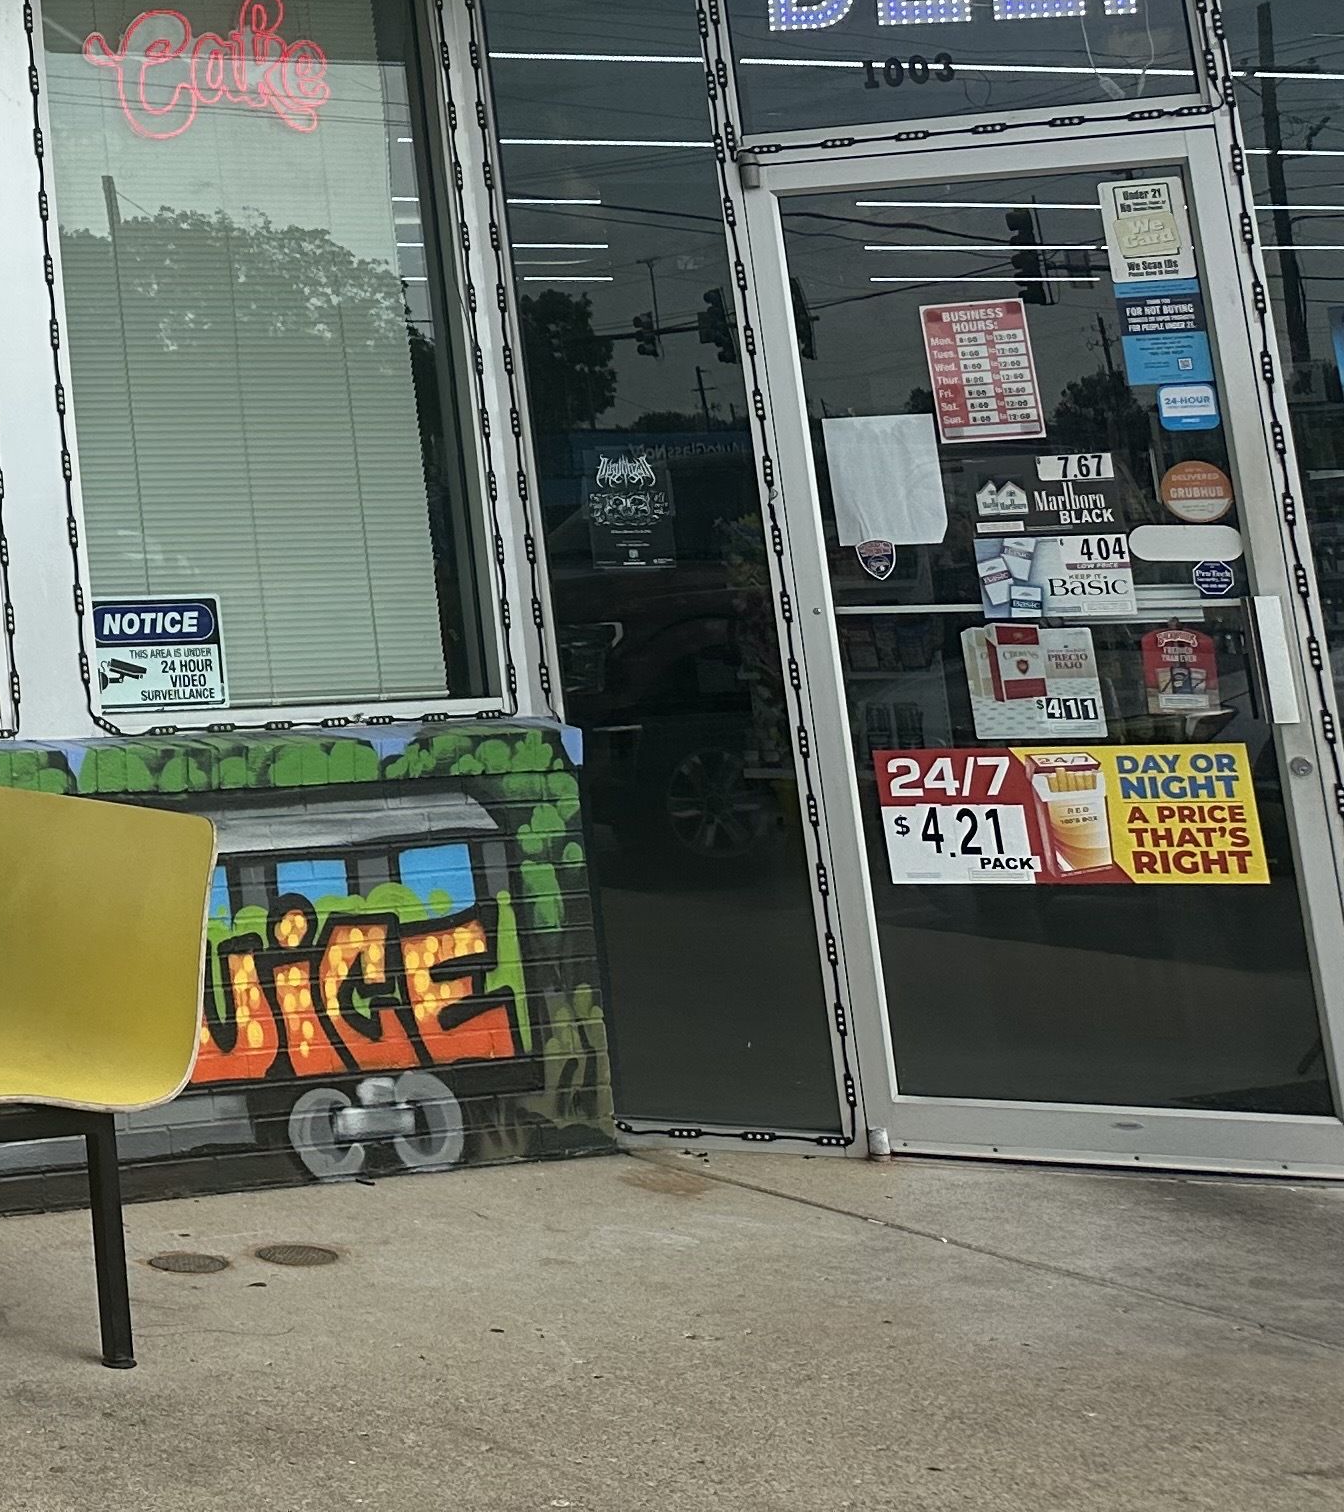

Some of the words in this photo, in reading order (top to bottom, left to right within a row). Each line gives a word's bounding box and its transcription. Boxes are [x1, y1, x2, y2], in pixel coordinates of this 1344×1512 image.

[862, 52, 955, 89] 1003
[941, 308, 1003, 322] BUSINESS
[952, 320, 998, 332] HOURS:
[1164, 396, 1210, 405] 24-HOUR
[1057, 454, 1103, 479] 7.67
[1034, 482, 1105, 512] Marlboro
[1170, 486, 1223, 498] GRUBHUB
[1059, 508, 1114, 524] BLACK
[1048, 575, 1128, 596] Basic
[102, 611, 199, 635] NOTICE
[129, 649, 148, 659] THIS
[150, 649, 172, 658] AREA
[174, 648, 182, 657] IS
[184, 647, 212, 657] UNDER
[1048, 653, 1088, 662] PRECIO
[161, 660, 177, 673] 24
[180, 659, 213, 672] HOUR
[170, 673, 207, 688] VIDEO
[140, 688, 215, 701] SURVEILLANCE
[1116, 754, 1181, 774] DAY
[1189, 753, 1237, 773] OR
[887, 756, 1010, 797] 24/7
[1119, 775, 1240, 799] NIGHT
[1127, 805, 1150, 824] A
[1156, 805, 1247, 824] PRICE
[894, 814, 910, 837] $
[921, 806, 1005, 858] 4.21
[1127, 826, 1250, 847] THAT'S
[980, 857, 1034, 869] PACK
[1132, 850, 1253, 874] RIGHT
